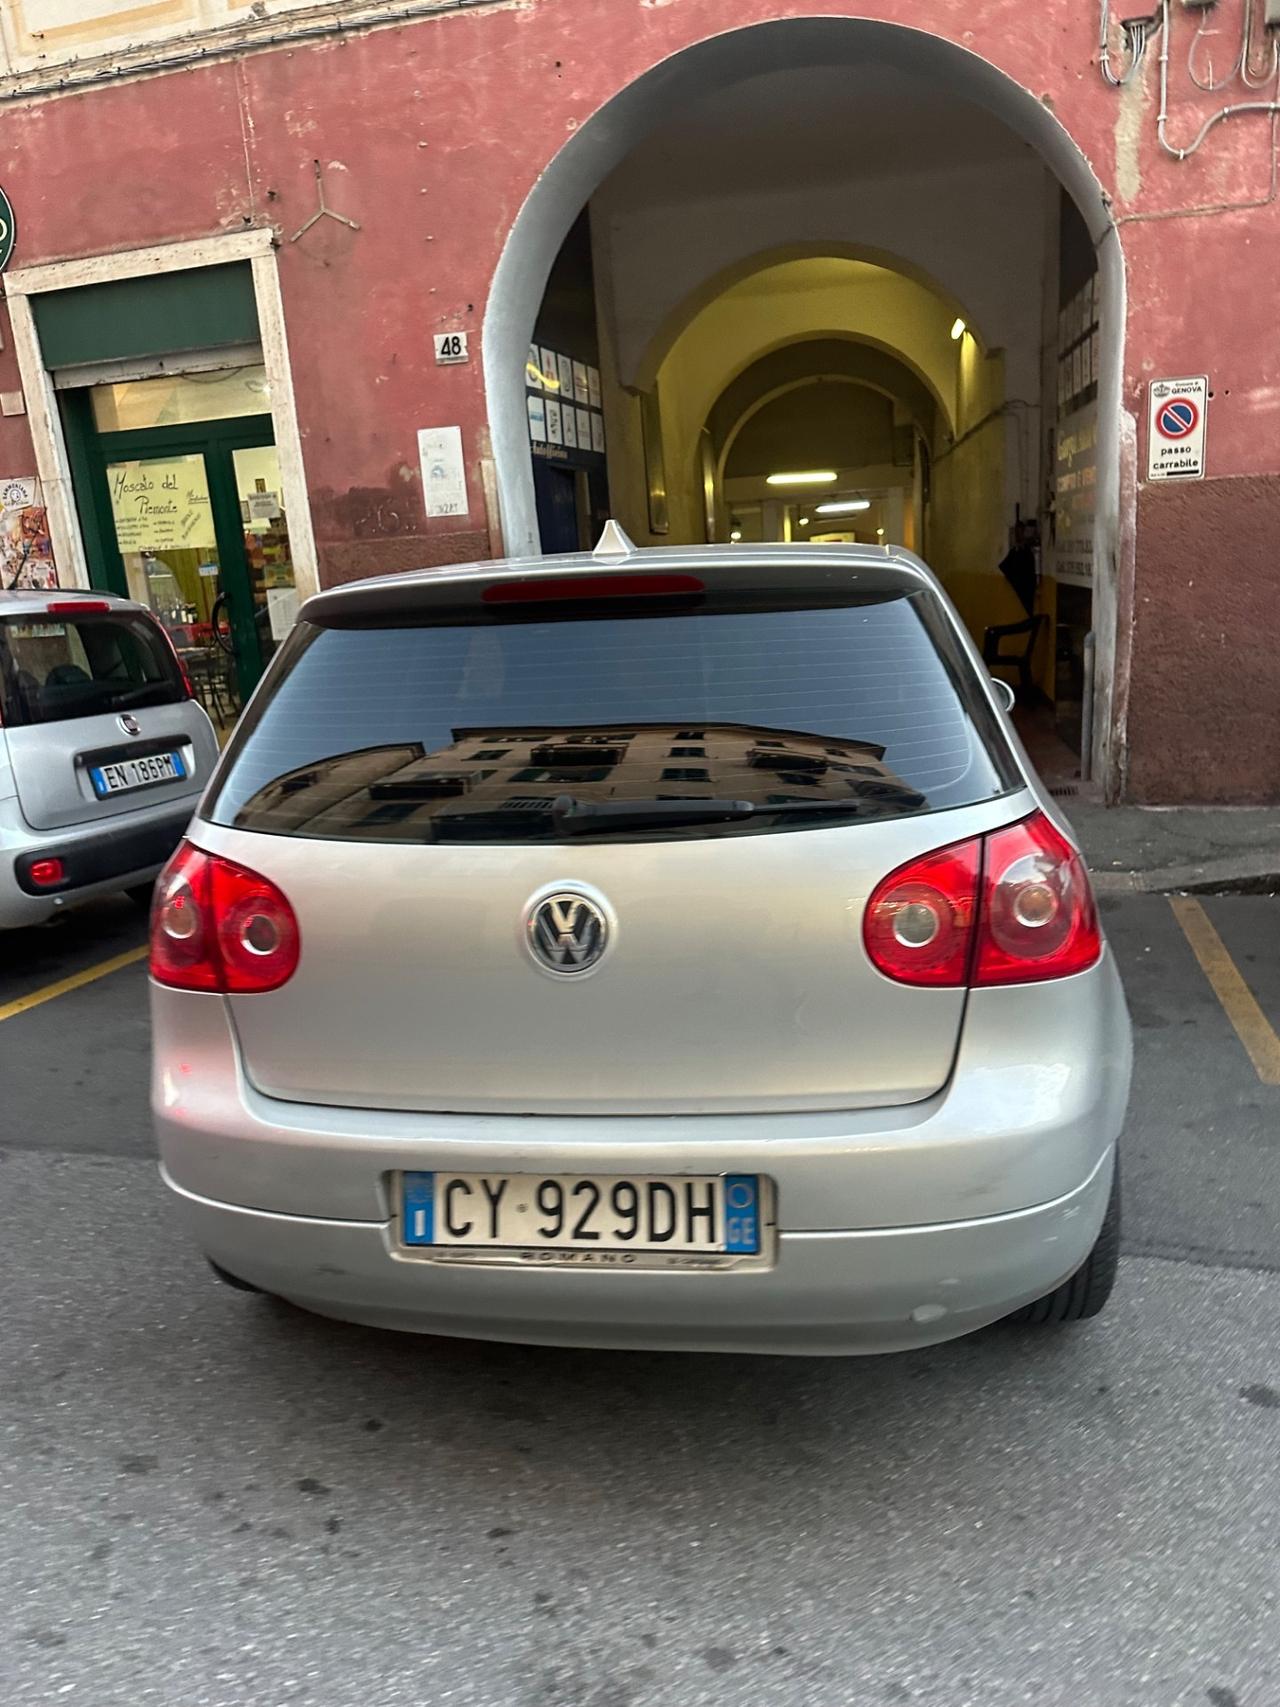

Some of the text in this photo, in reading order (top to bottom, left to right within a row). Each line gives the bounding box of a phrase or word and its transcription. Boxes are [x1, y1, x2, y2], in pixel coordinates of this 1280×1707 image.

[441, 336, 461, 355] 48
[1171, 386, 1202, 394] GENOVA
[1161, 446, 1191, 456] passo
[1153, 459, 1198, 470] carrabile
[114, 471, 178, 500] Moscato del
[104, 765, 128, 789] EN
[444, 1179, 509, 1239] CY
[536, 1179, 717, 1243] 929DH
[521, 1251, 637, 1263] ROMANO
